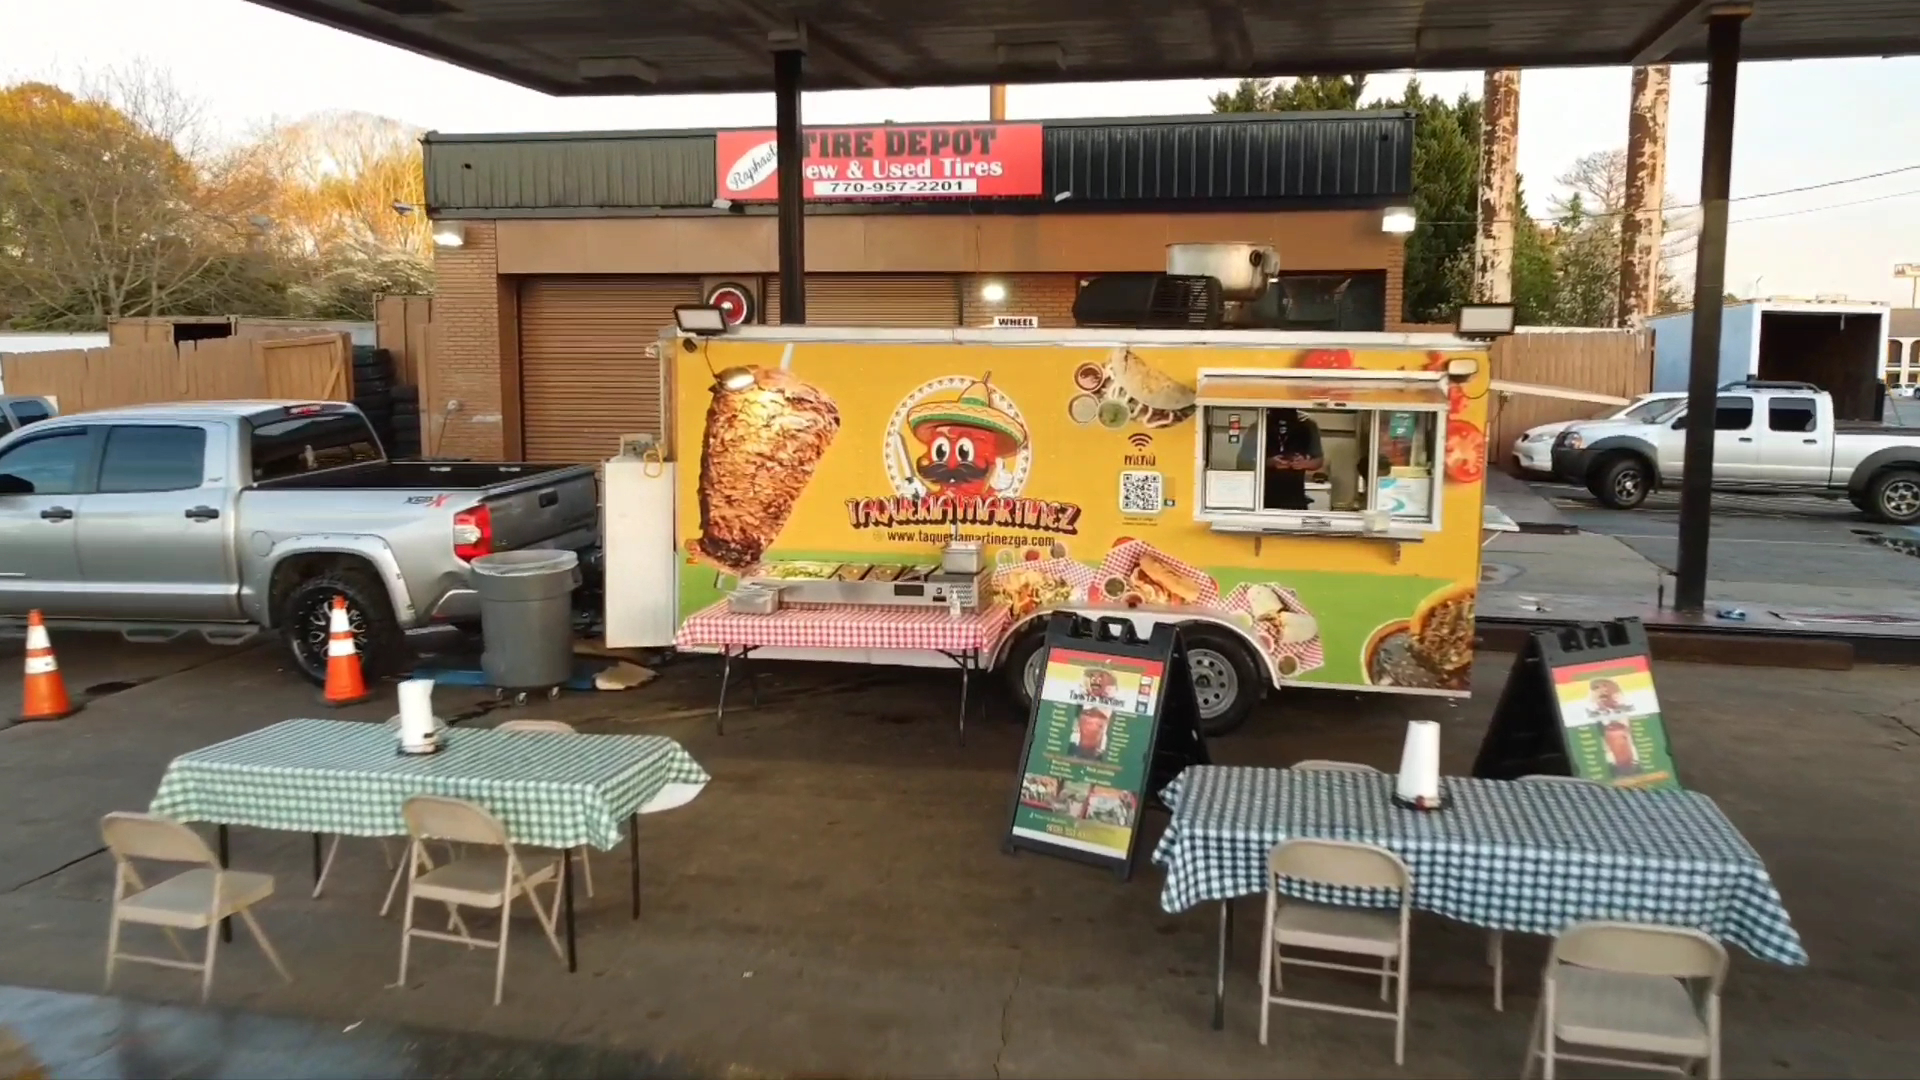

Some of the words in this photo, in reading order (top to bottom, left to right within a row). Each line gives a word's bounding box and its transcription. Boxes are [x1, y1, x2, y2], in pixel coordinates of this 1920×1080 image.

[802, 131, 873, 158] TIRE
[885, 128, 997, 157] DEPOT
[730, 143, 778, 188] Raphael
[802, 163, 838, 180] ew
[846, 160, 863, 179] &
[872, 158, 931, 178] Used
[940, 157, 1003, 177] Tires
[830, 181, 963, 193] 770-957-2201
[998, 318, 1034, 326] WHEEL
[844, 495, 955, 529] TAQUERIA
[954, 494, 1082, 535] MARTINEZ
